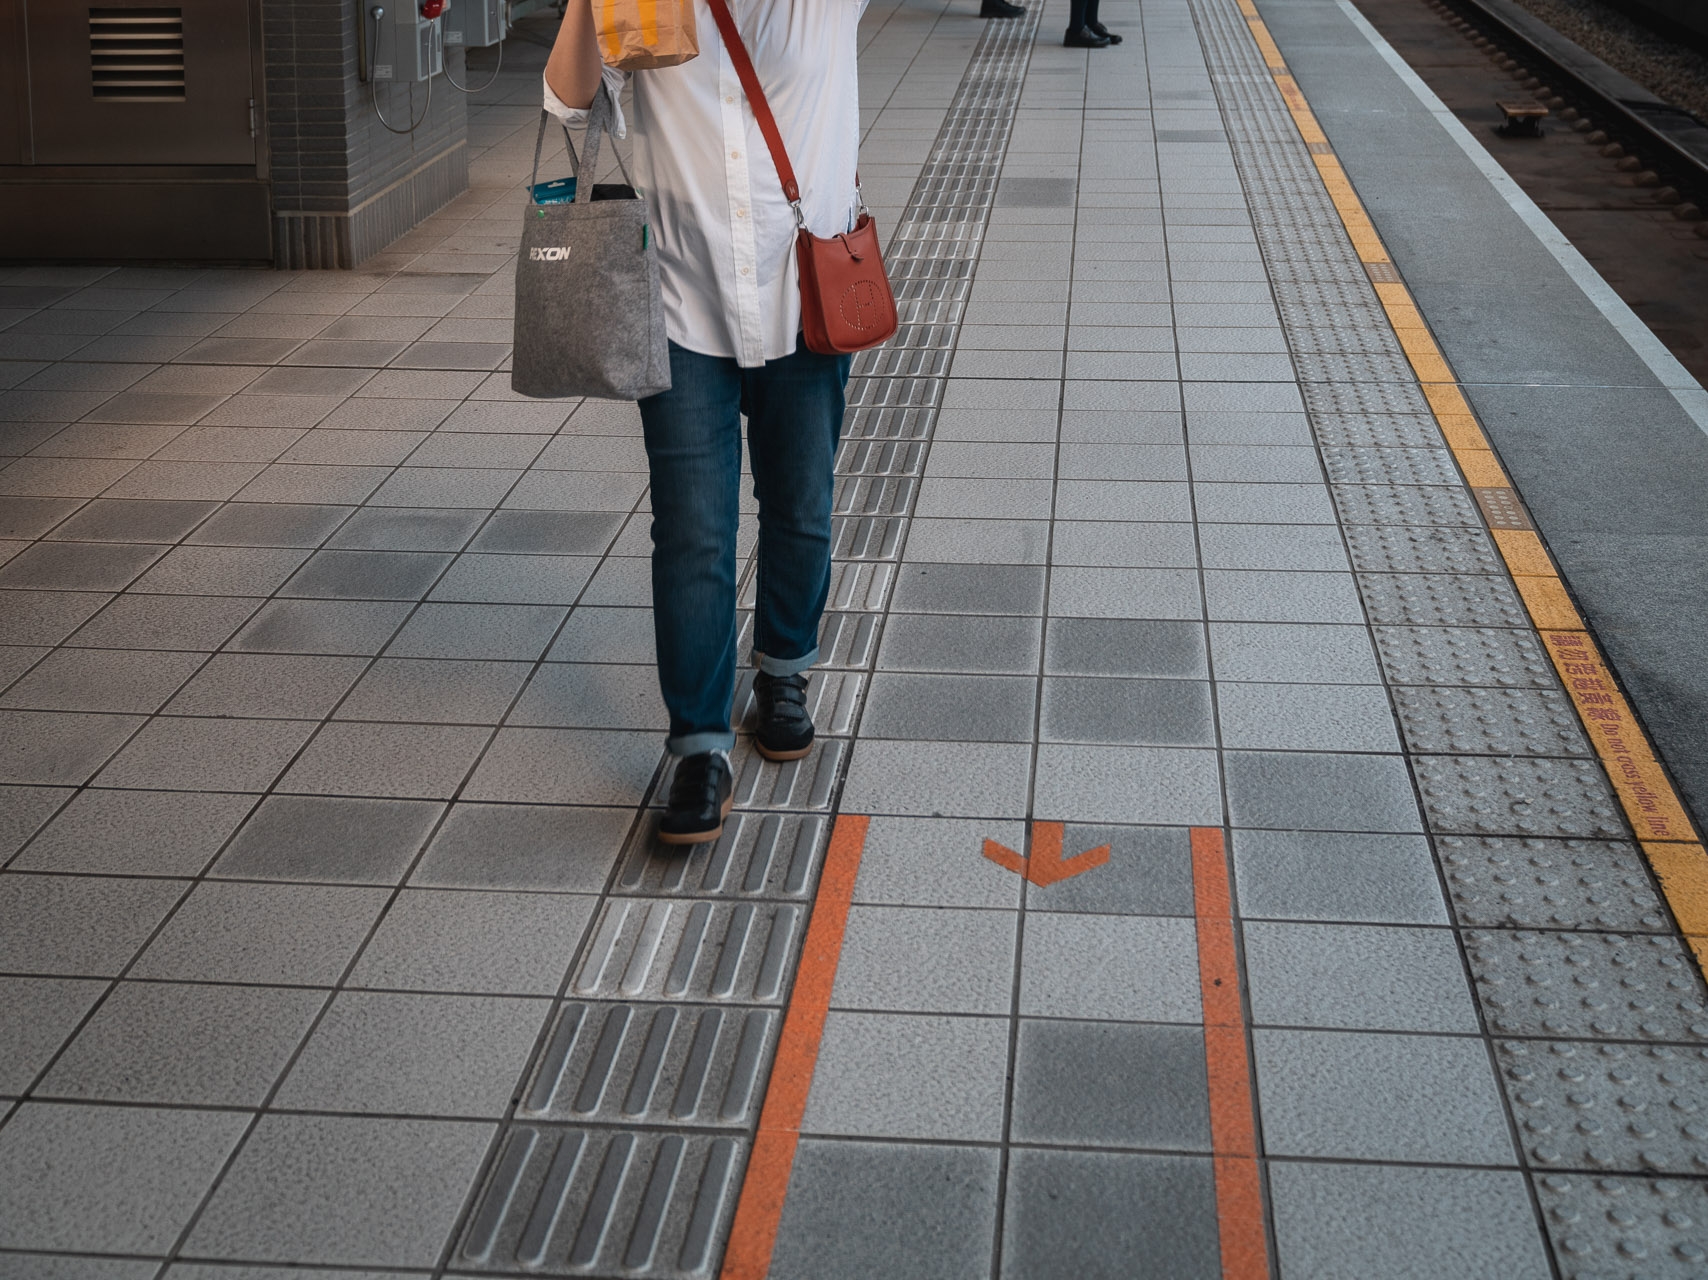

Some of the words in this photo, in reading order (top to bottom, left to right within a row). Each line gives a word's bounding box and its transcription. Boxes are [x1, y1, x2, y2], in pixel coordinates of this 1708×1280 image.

[1549, 634, 1622, 721] 請勿跨越黃線
[1600, 723, 1619, 736] Do
[1610, 738, 1631, 753] not
[1616, 753, 1641, 780] cross
[1625, 779, 1659, 813] yellow
[1647, 815, 1671, 837] line
